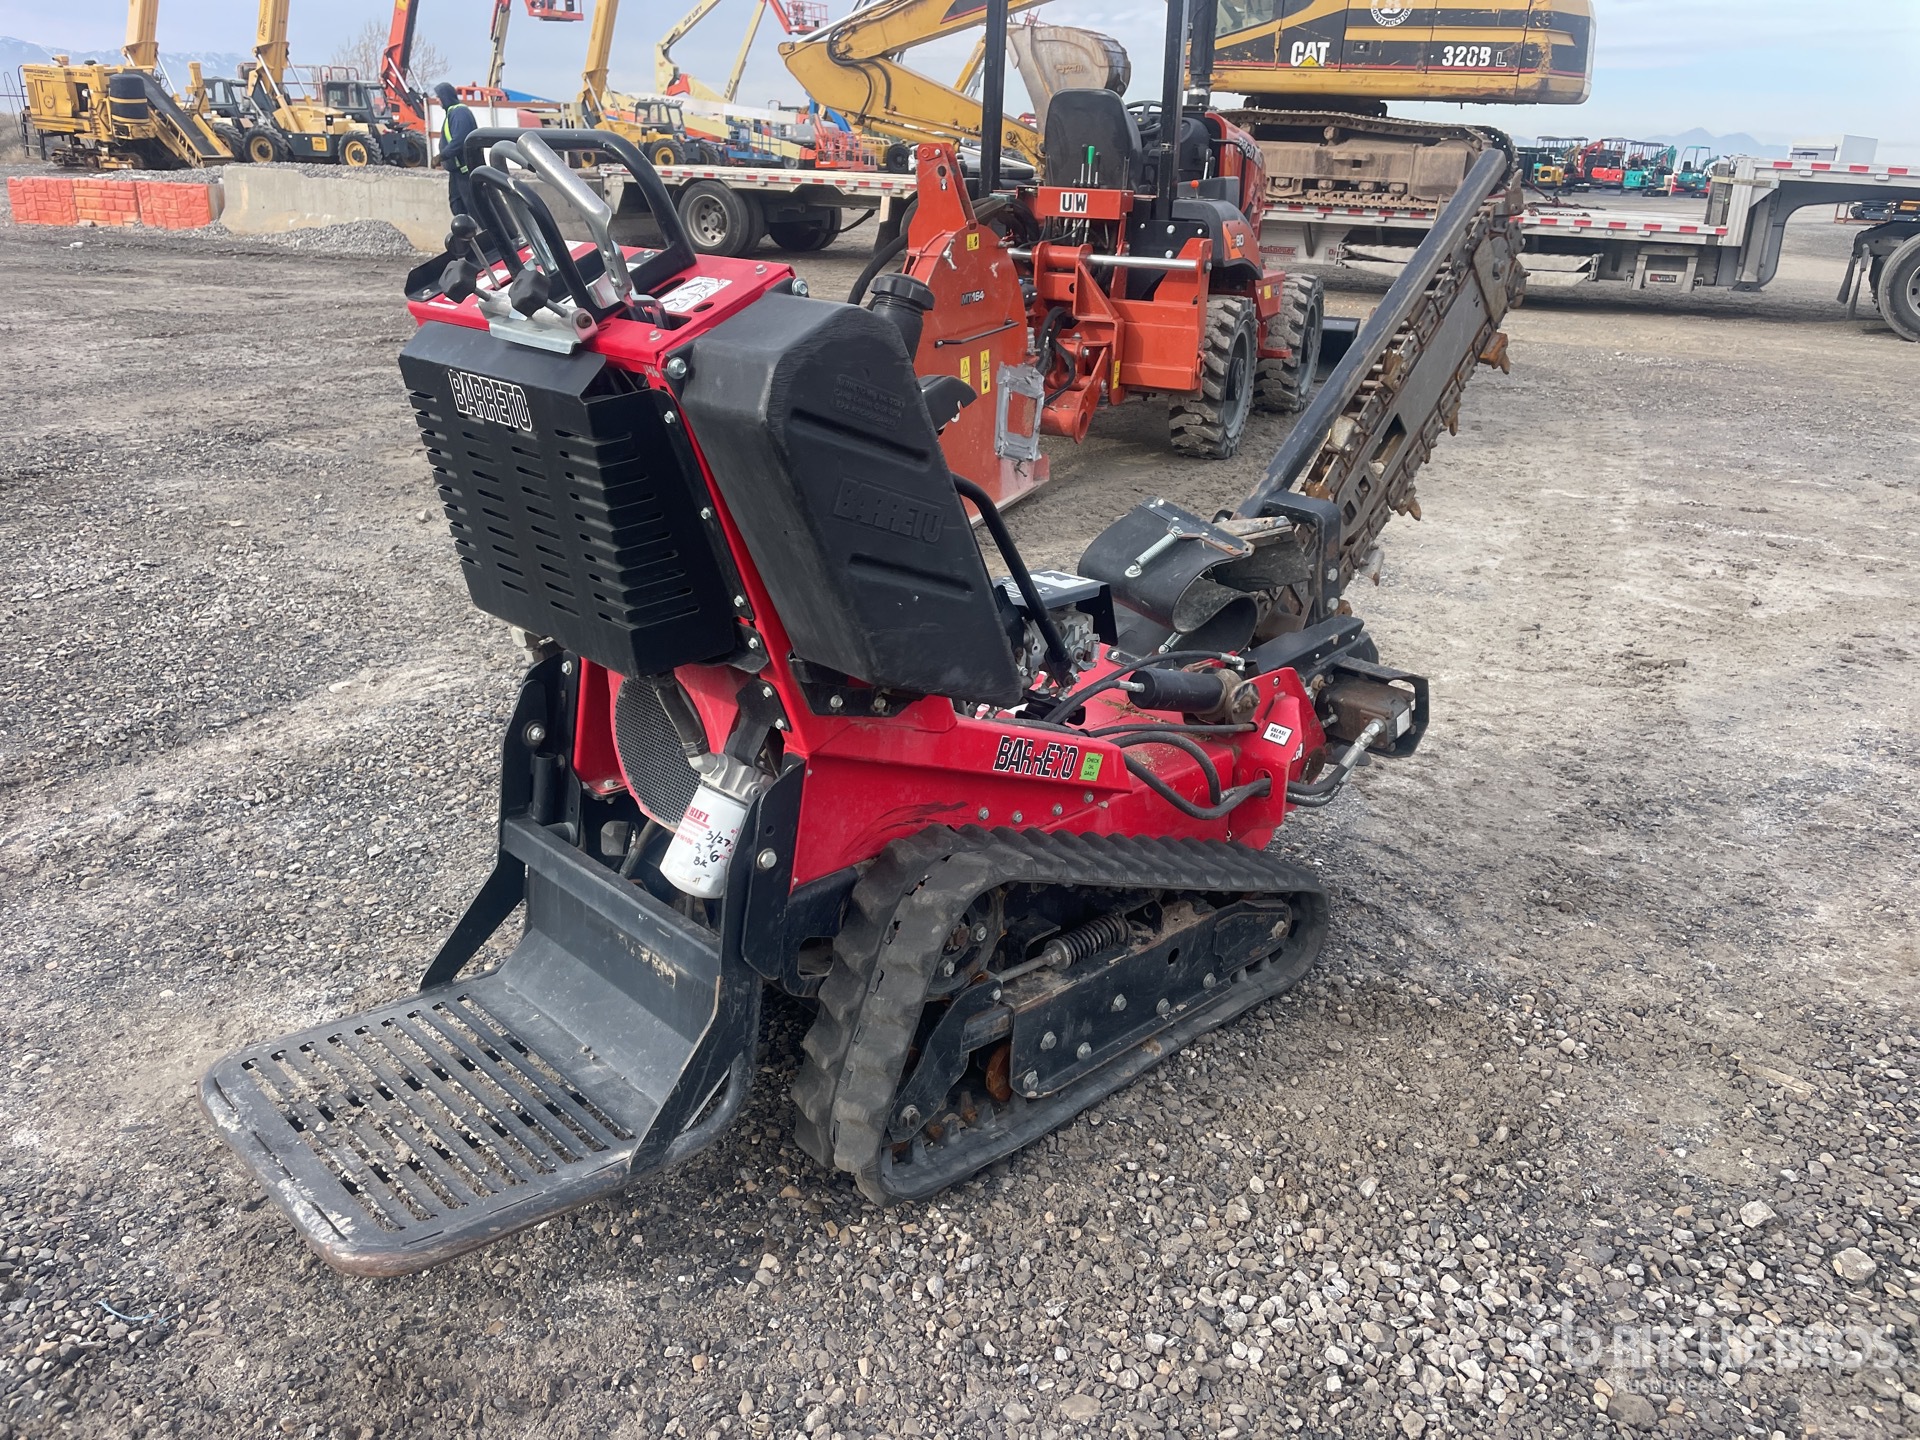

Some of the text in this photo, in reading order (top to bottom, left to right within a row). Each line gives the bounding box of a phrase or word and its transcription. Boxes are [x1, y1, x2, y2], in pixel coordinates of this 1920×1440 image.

[1290, 41, 1331, 67] CAT
[1442, 45, 1492, 67] 320B
[448, 369, 533, 433] BARRETO
[833, 478, 945, 543] BARRETO
